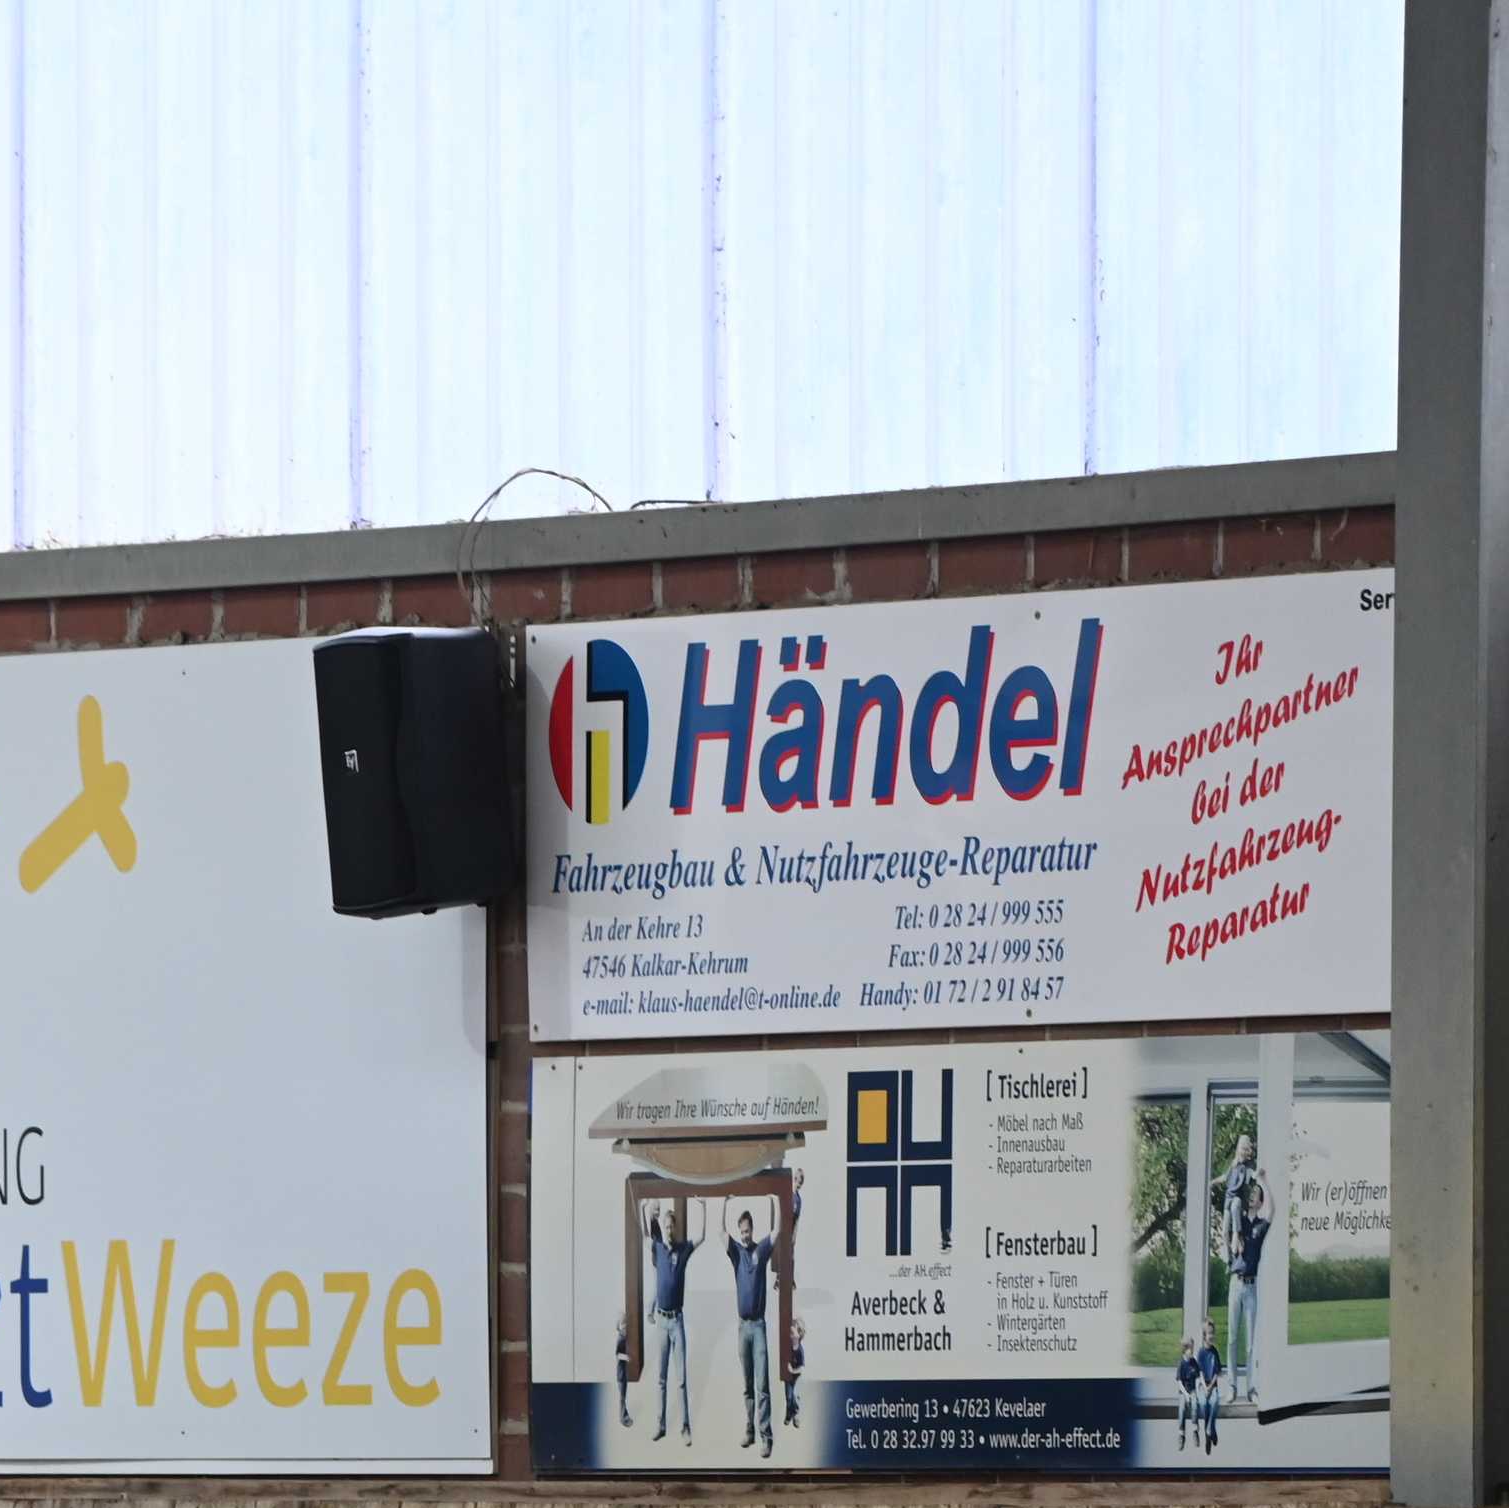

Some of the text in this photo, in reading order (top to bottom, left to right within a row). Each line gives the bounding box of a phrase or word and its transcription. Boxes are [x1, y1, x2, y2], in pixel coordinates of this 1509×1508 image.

[1215, 632, 1264, 686] Ihr
[669, 617, 1104, 816] Händel
[1121, 665, 1360, 791] Ansprechpartner
[1190, 758, 1285, 826] bei der
[551, 836, 1099, 901] Fahrzeugbau & Nutzfahrzeuge-Reparatur
[1135, 807, 1343, 913] Nutzfahrzeug-
[582, 913, 704, 943] An der Kehre 13
[895, 904, 924, 930] Tel:
[943, 903, 963, 928] 28
[967, 901, 988, 927] 24
[1002, 899, 1031, 926] 999
[1034, 898, 1064, 926] 555
[1166, 881, 1311, 965] Reparatur
[582, 950, 749, 979] 47546 Kalkar-Kehrum
[887, 943, 925, 968] Fax:
[943, 941, 963, 966] 28
[967, 939, 987, 965] 24
[1002, 938, 1031, 964] 999
[1035, 937, 1065, 963] 556
[582, 983, 842, 1017] e-mail: klaus-haendel@t-online.de
[860, 980, 919, 1011] Handy:
[947, 978, 966, 1004] 72
[997, 976, 1015, 1002] 91
[1020, 976, 1041, 1002] 84
[1044, 975, 1065, 1001] 57
[997, 1071, 1078, 1100] Tischlerei
[615, 1095, 820, 1124] Wir tragen Ihre Wünsche auf Händen!
[997, 1111, 1085, 1133] Möbel nach Maß
[996, 1133, 1066, 1153] Innenausbau
[996, 1153, 1093, 1179] Reparaturarbeiten
[1301, 1179, 1389, 1207] Wir (er)öffnen
[1300, 1215, 1330, 1231] neue
[996, 1229, 1086, 1257] Fensterbau
[996, 1270, 1078, 1290] Fenster Türen
[851, 1288, 947, 1316] Averbeck &
[996, 1289, 1109, 1310] in Holz u. Kunststoff
[844, 1324, 952, 1352] Hammerbach
[996, 1312, 1067, 1336] Wintergärten
[996, 1333, 1079, 1352] Insektenschutz
[845, 1396, 1047, 1424] Gewerbering 13 47623 Kevelaer
[845, 1426, 1121, 1450] Tel. 0 28 32.97 99 33 www.der-ah-effect.de
